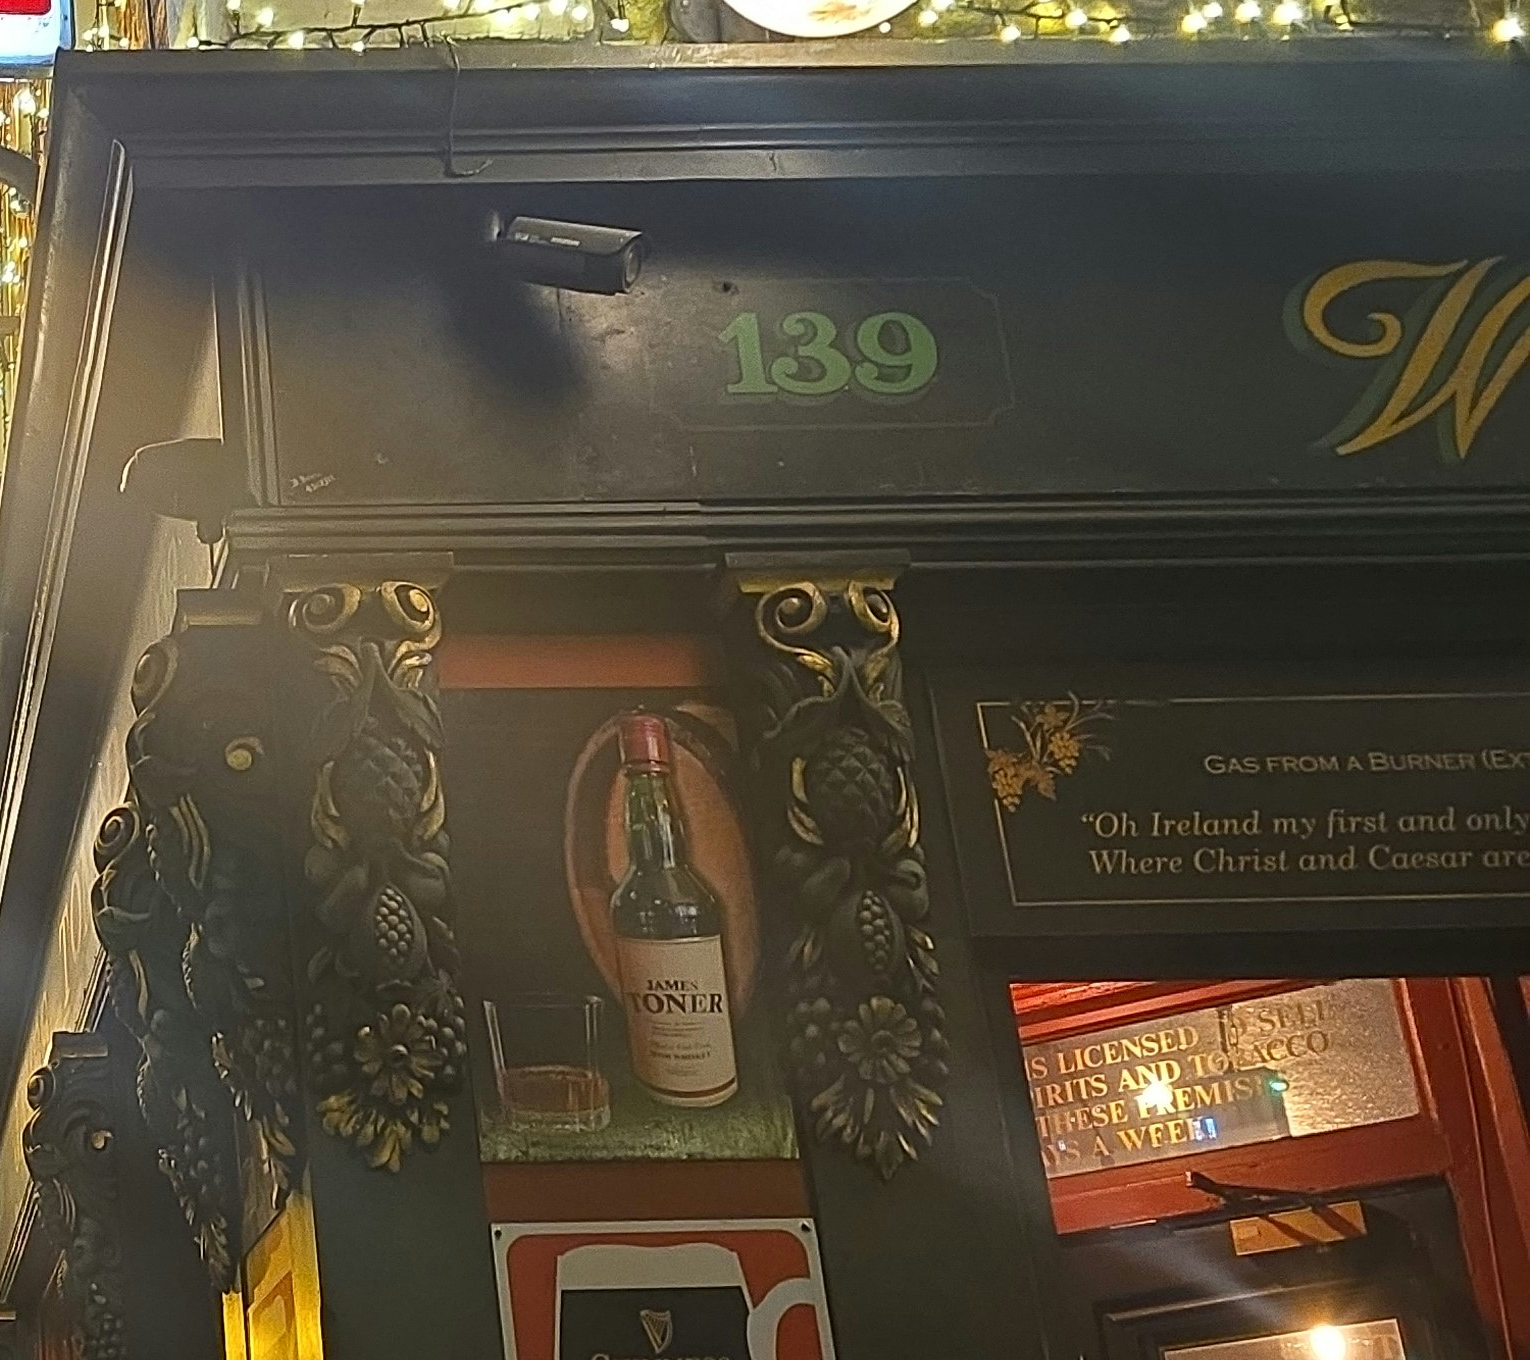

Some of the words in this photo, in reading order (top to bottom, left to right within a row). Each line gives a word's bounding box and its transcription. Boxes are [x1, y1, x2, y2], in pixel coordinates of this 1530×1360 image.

[716, 311, 940, 400] 139
[1204, 753, 1261, 774] GAS
[1267, 754, 1339, 773] FROM
[1346, 754, 1363, 772] A
[1369, 750, 1475, 772] BURNER
[1149, 808, 1261, 837] Ireland
[1271, 814, 1318, 840] my
[1327, 808, 1387, 839] first
[1398, 806, 1456, 833] and
[1466, 805, 1530, 836] only
[1088, 847, 1182, 875] Where
[1192, 845, 1289, 874] Christ
[1298, 845, 1357, 872] and
[1367, 843, 1472, 871] Caesar
[646, 979, 698, 991] JAMES
[630, 993, 723, 1015] TONER
[1057, 1024, 1199, 1075] LICENSED
[1118, 1058, 1181, 1093] AND
